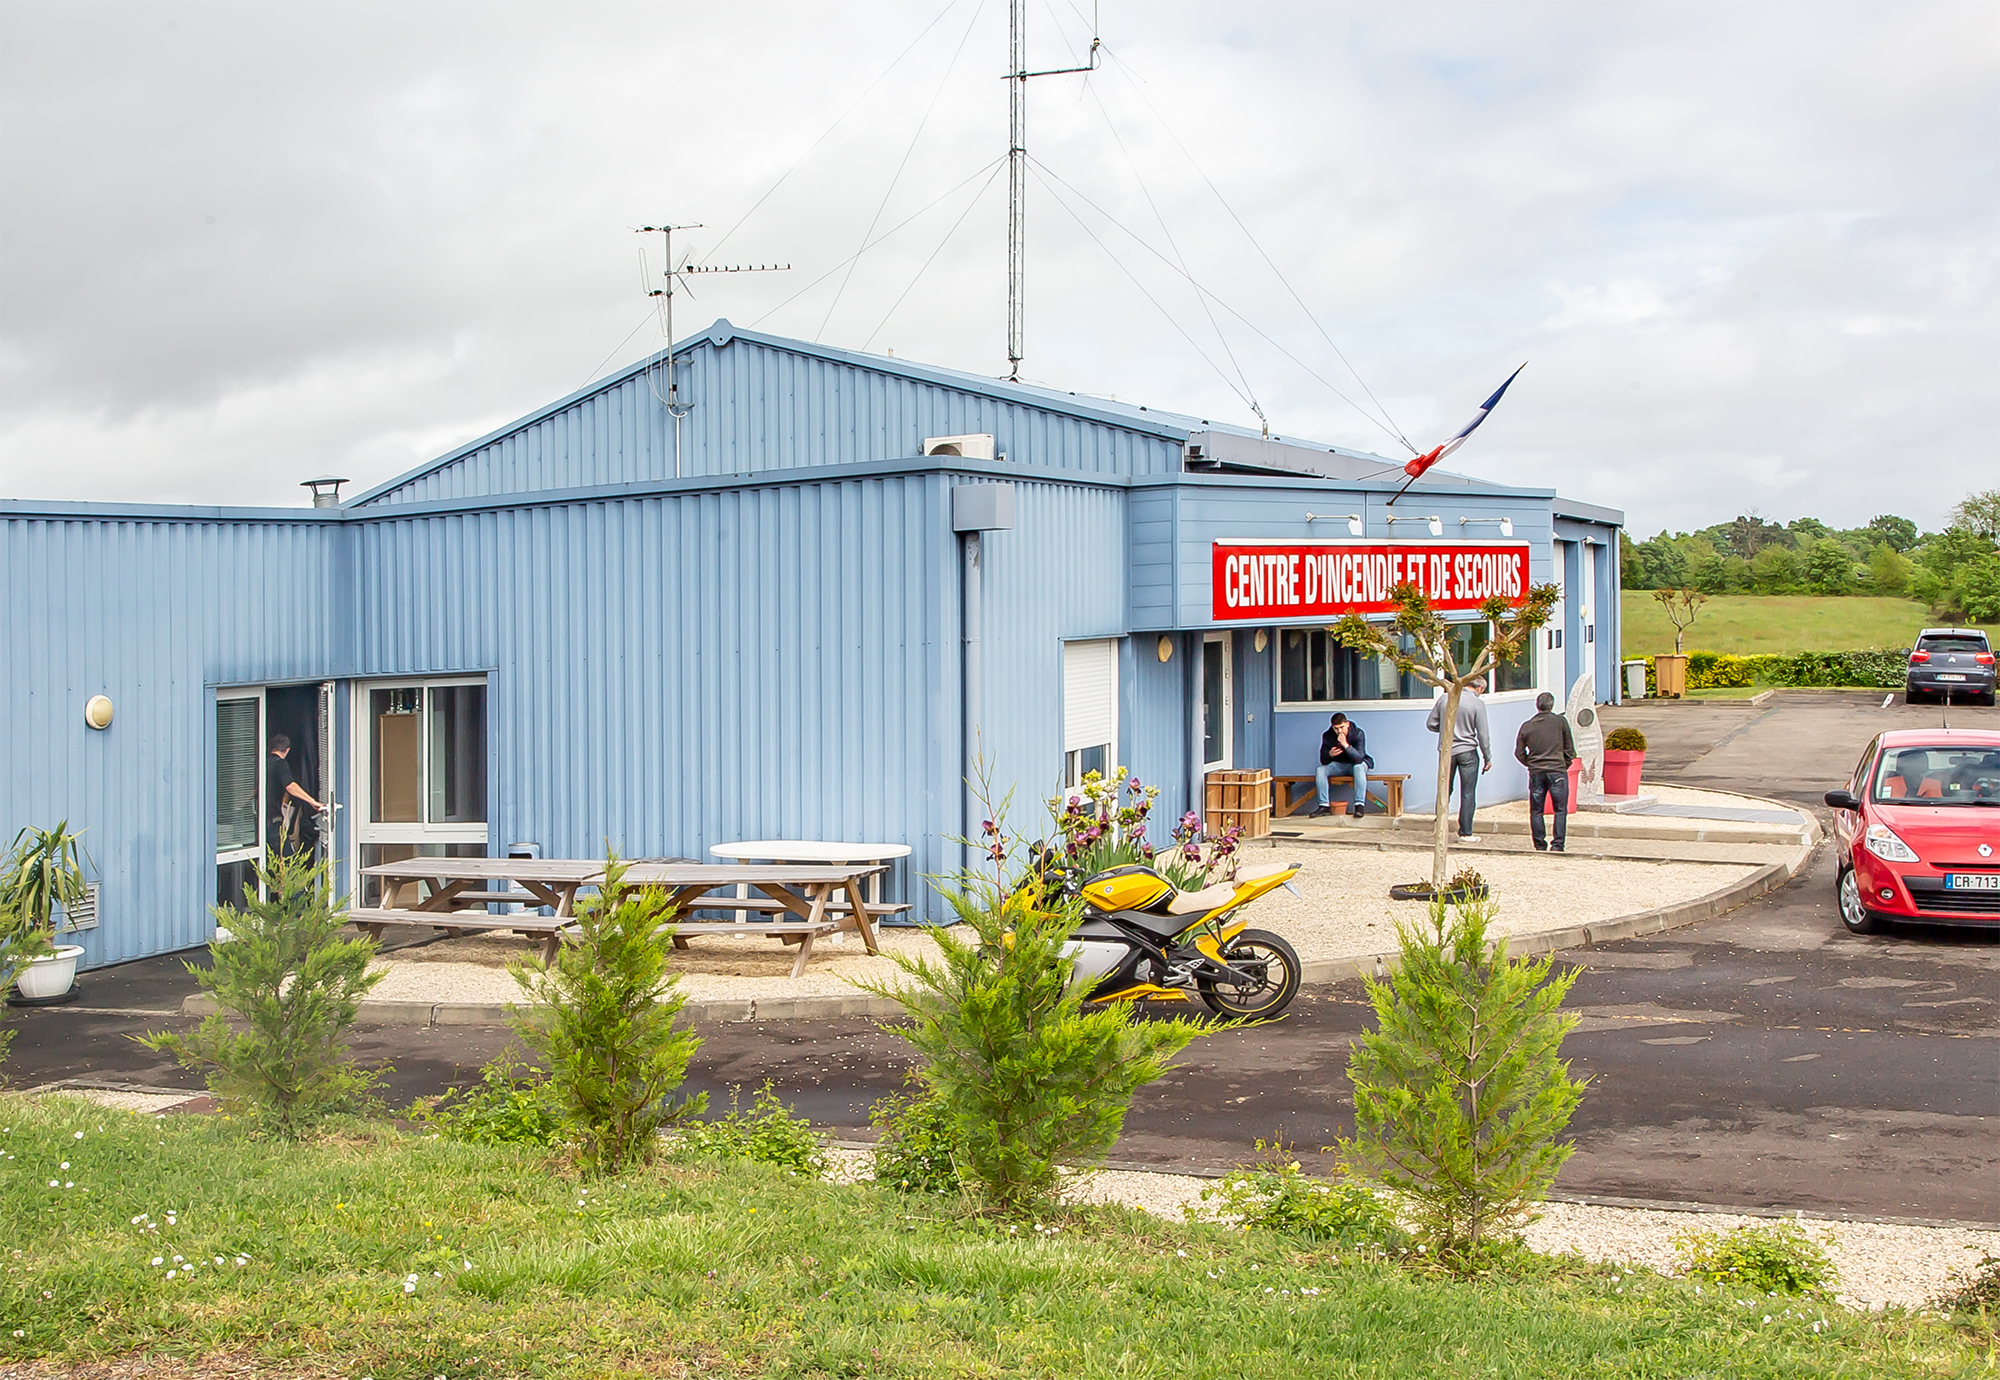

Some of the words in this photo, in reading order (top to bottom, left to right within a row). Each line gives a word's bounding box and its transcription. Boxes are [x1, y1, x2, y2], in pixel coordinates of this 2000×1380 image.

[1225, 554, 1300, 608] CENTRE
[1305, 553, 1402, 604] D'INCENDIE
[1407, 554, 1427, 600] ET
[1430, 554, 1451, 600] DE
[1454, 553, 1522, 600] SECOURS
